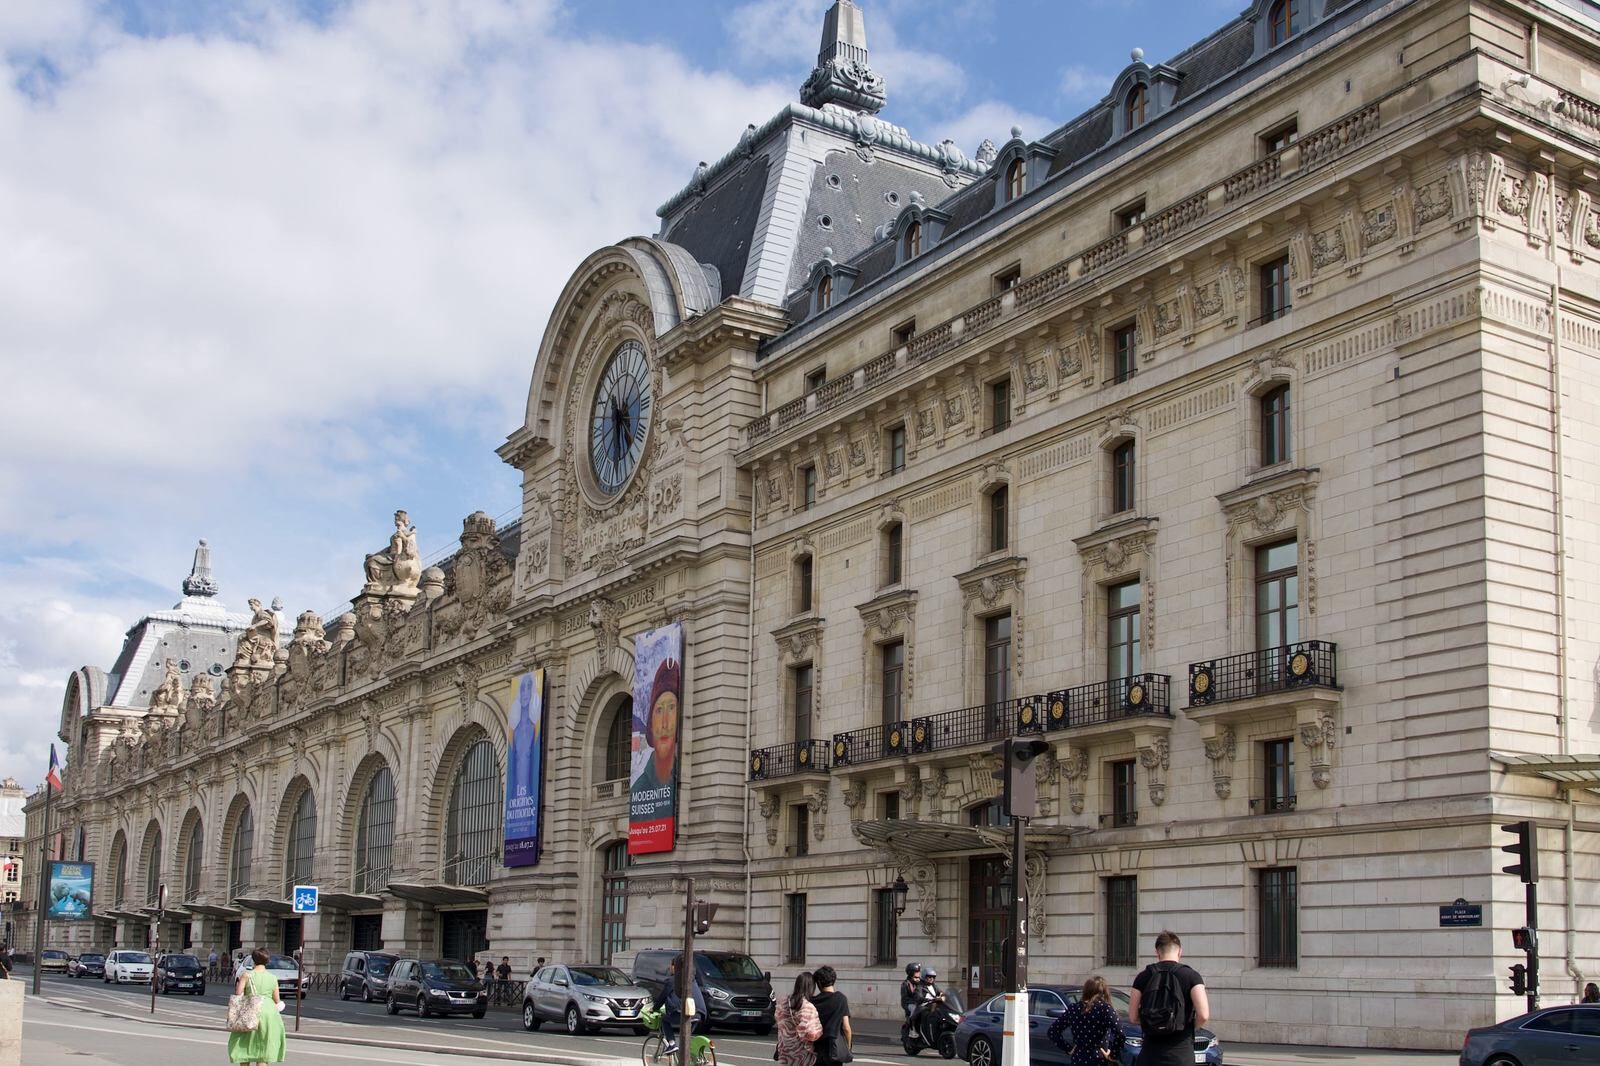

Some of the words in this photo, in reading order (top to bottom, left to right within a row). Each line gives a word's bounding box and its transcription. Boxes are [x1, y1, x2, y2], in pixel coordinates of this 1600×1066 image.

[652, 487, 674, 507] PO
[516, 784, 527, 796] Les
[632, 785, 671, 802] MODERNITÉS
[631, 803, 655, 816] SUISSES
[648, 824, 667, 833] 25.07.21
